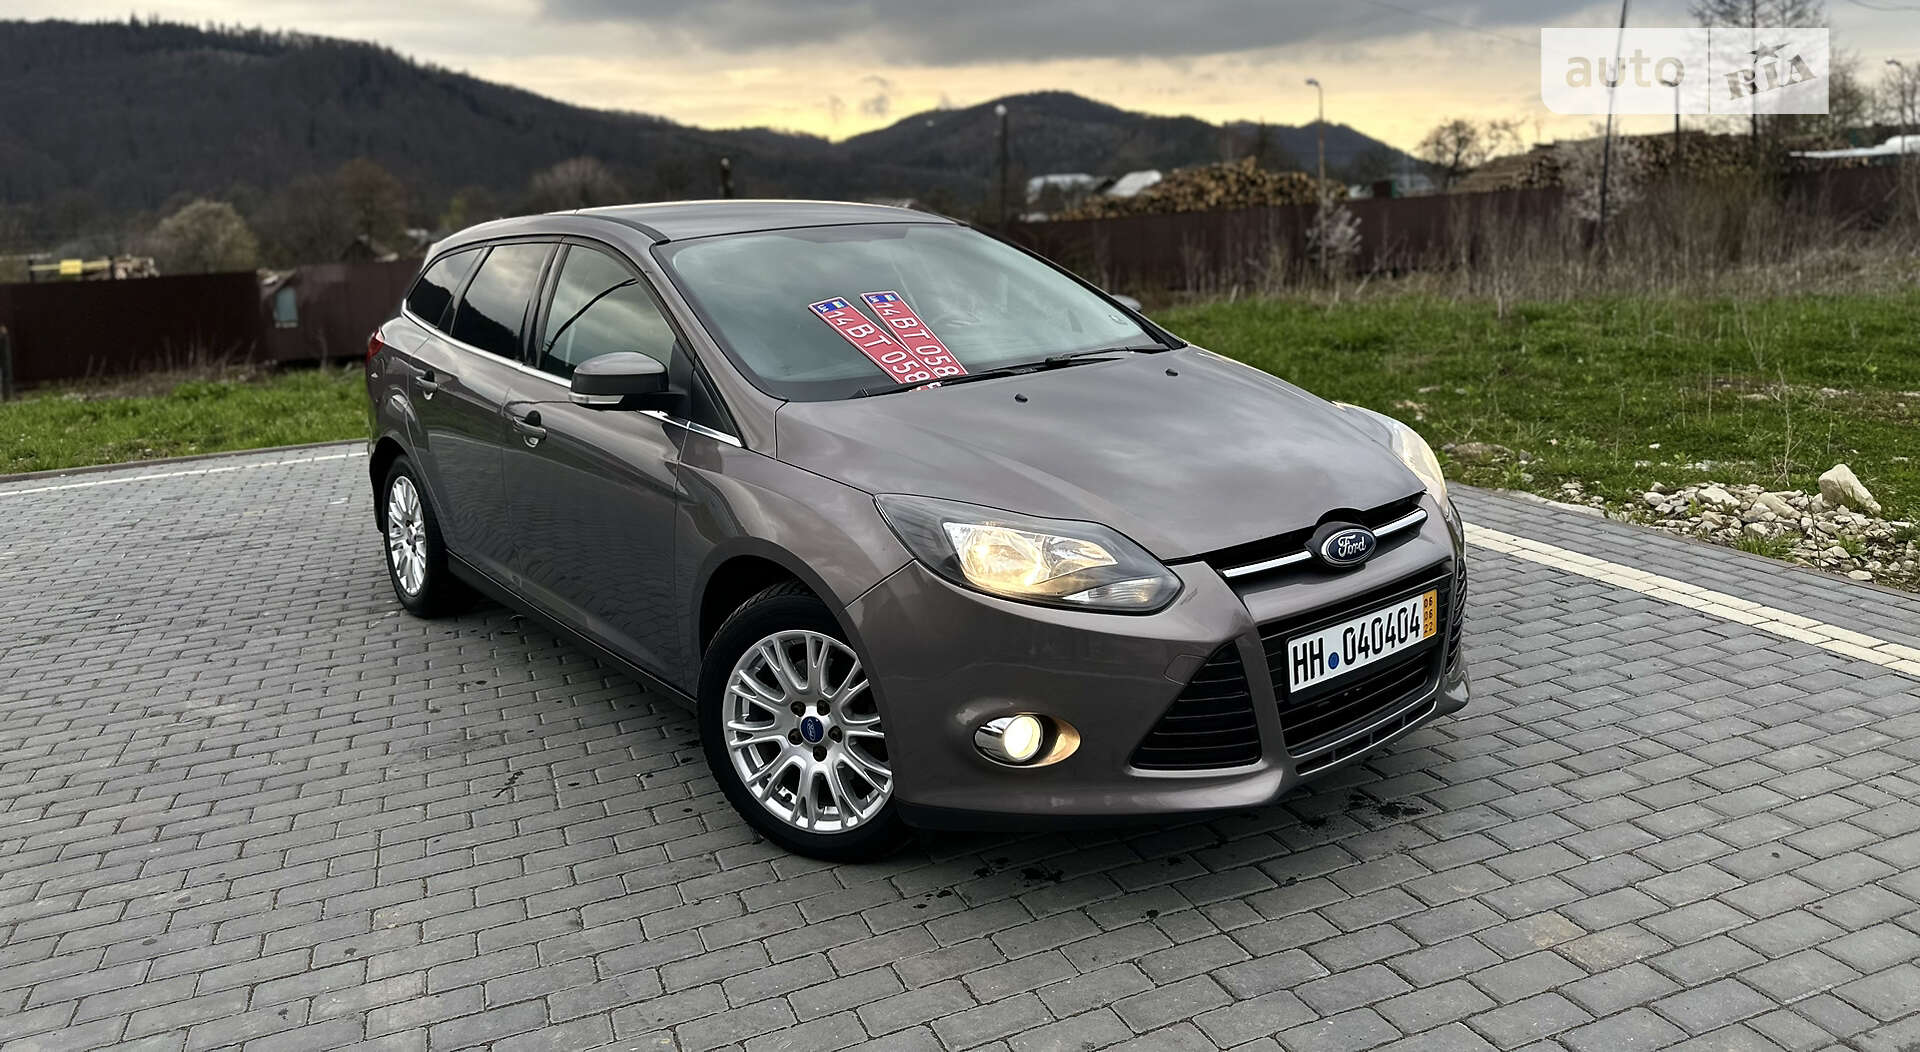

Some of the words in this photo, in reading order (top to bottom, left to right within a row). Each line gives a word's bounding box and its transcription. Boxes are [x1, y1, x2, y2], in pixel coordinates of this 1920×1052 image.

[1338, 534, 1367, 557] Ford
[1292, 637, 1325, 686] HH
[1342, 602, 1421, 666] 040404
